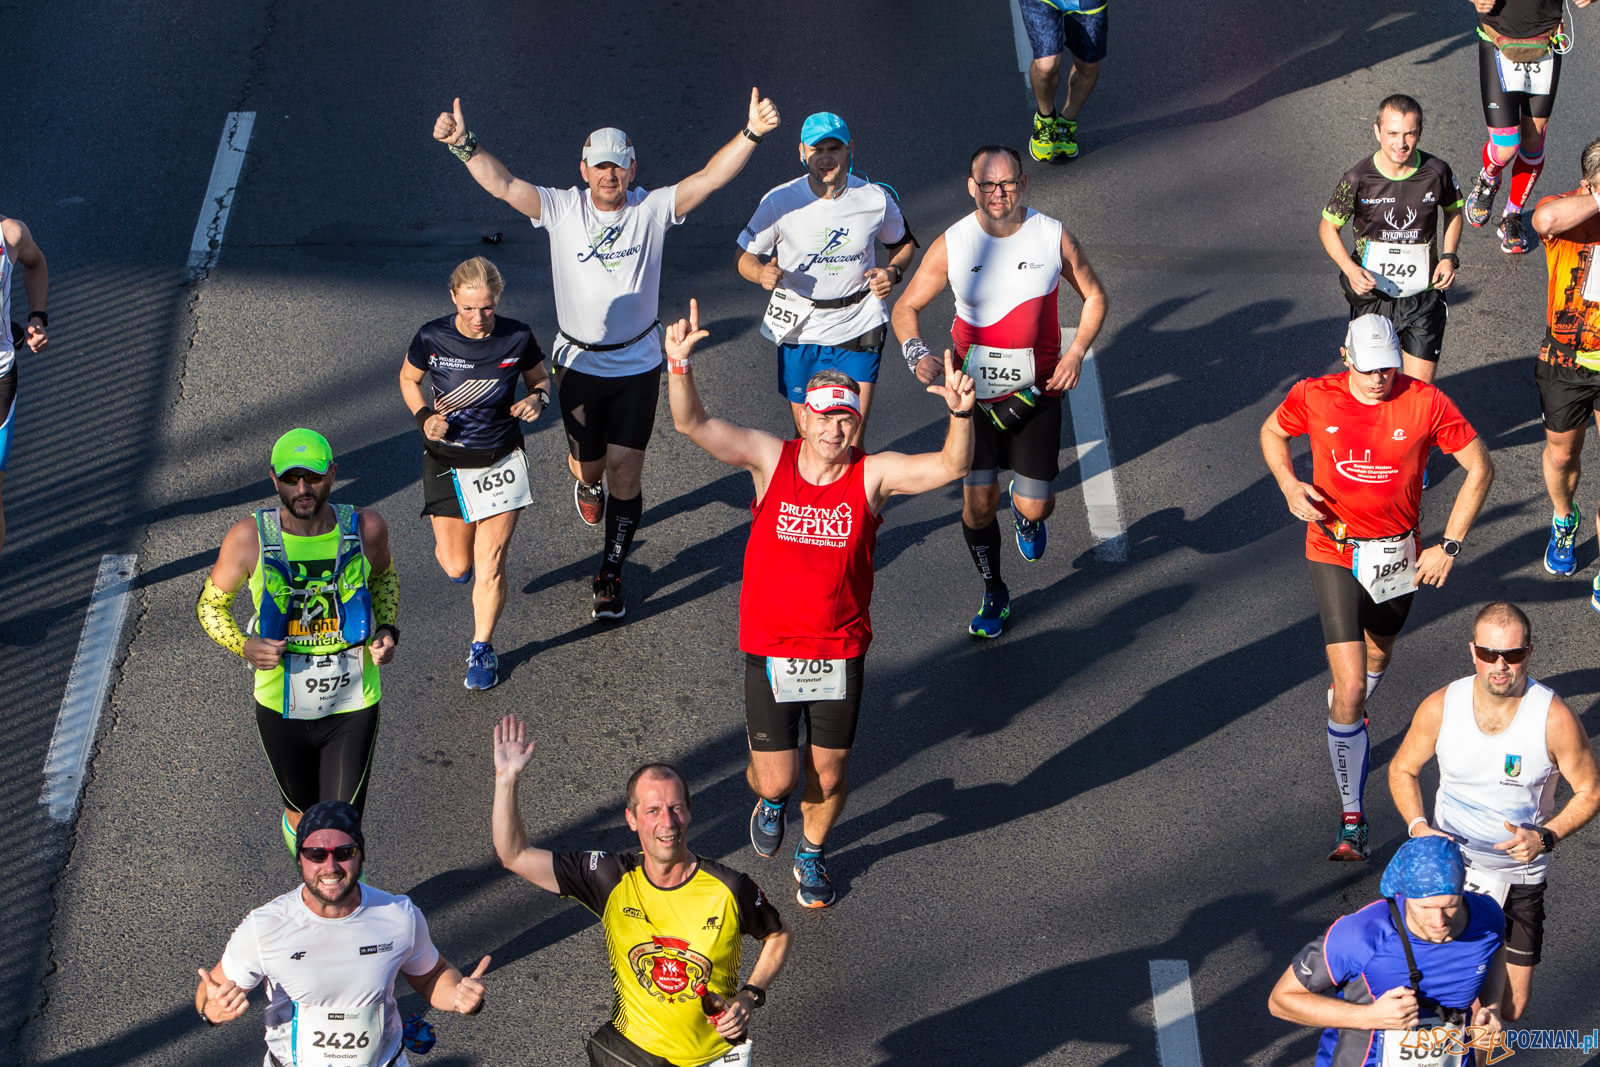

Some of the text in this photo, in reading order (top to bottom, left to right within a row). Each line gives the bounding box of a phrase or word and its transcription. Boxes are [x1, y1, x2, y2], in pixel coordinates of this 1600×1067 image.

[1379, 263, 1417, 278] 1249
[980, 367, 1021, 381] 1345
[473, 469, 515, 494] 1630
[779, 501, 839, 520] DRUŻYNA
[776, 514, 852, 537] SZPIKU
[777, 533, 846, 548] www.darszpiku.pl
[1373, 558, 1409, 580] 1899
[786, 657, 833, 675] 3705
[305, 672, 351, 693] 9575
[290, 951, 306, 960] 4F
[313, 1031, 370, 1049] 2426
